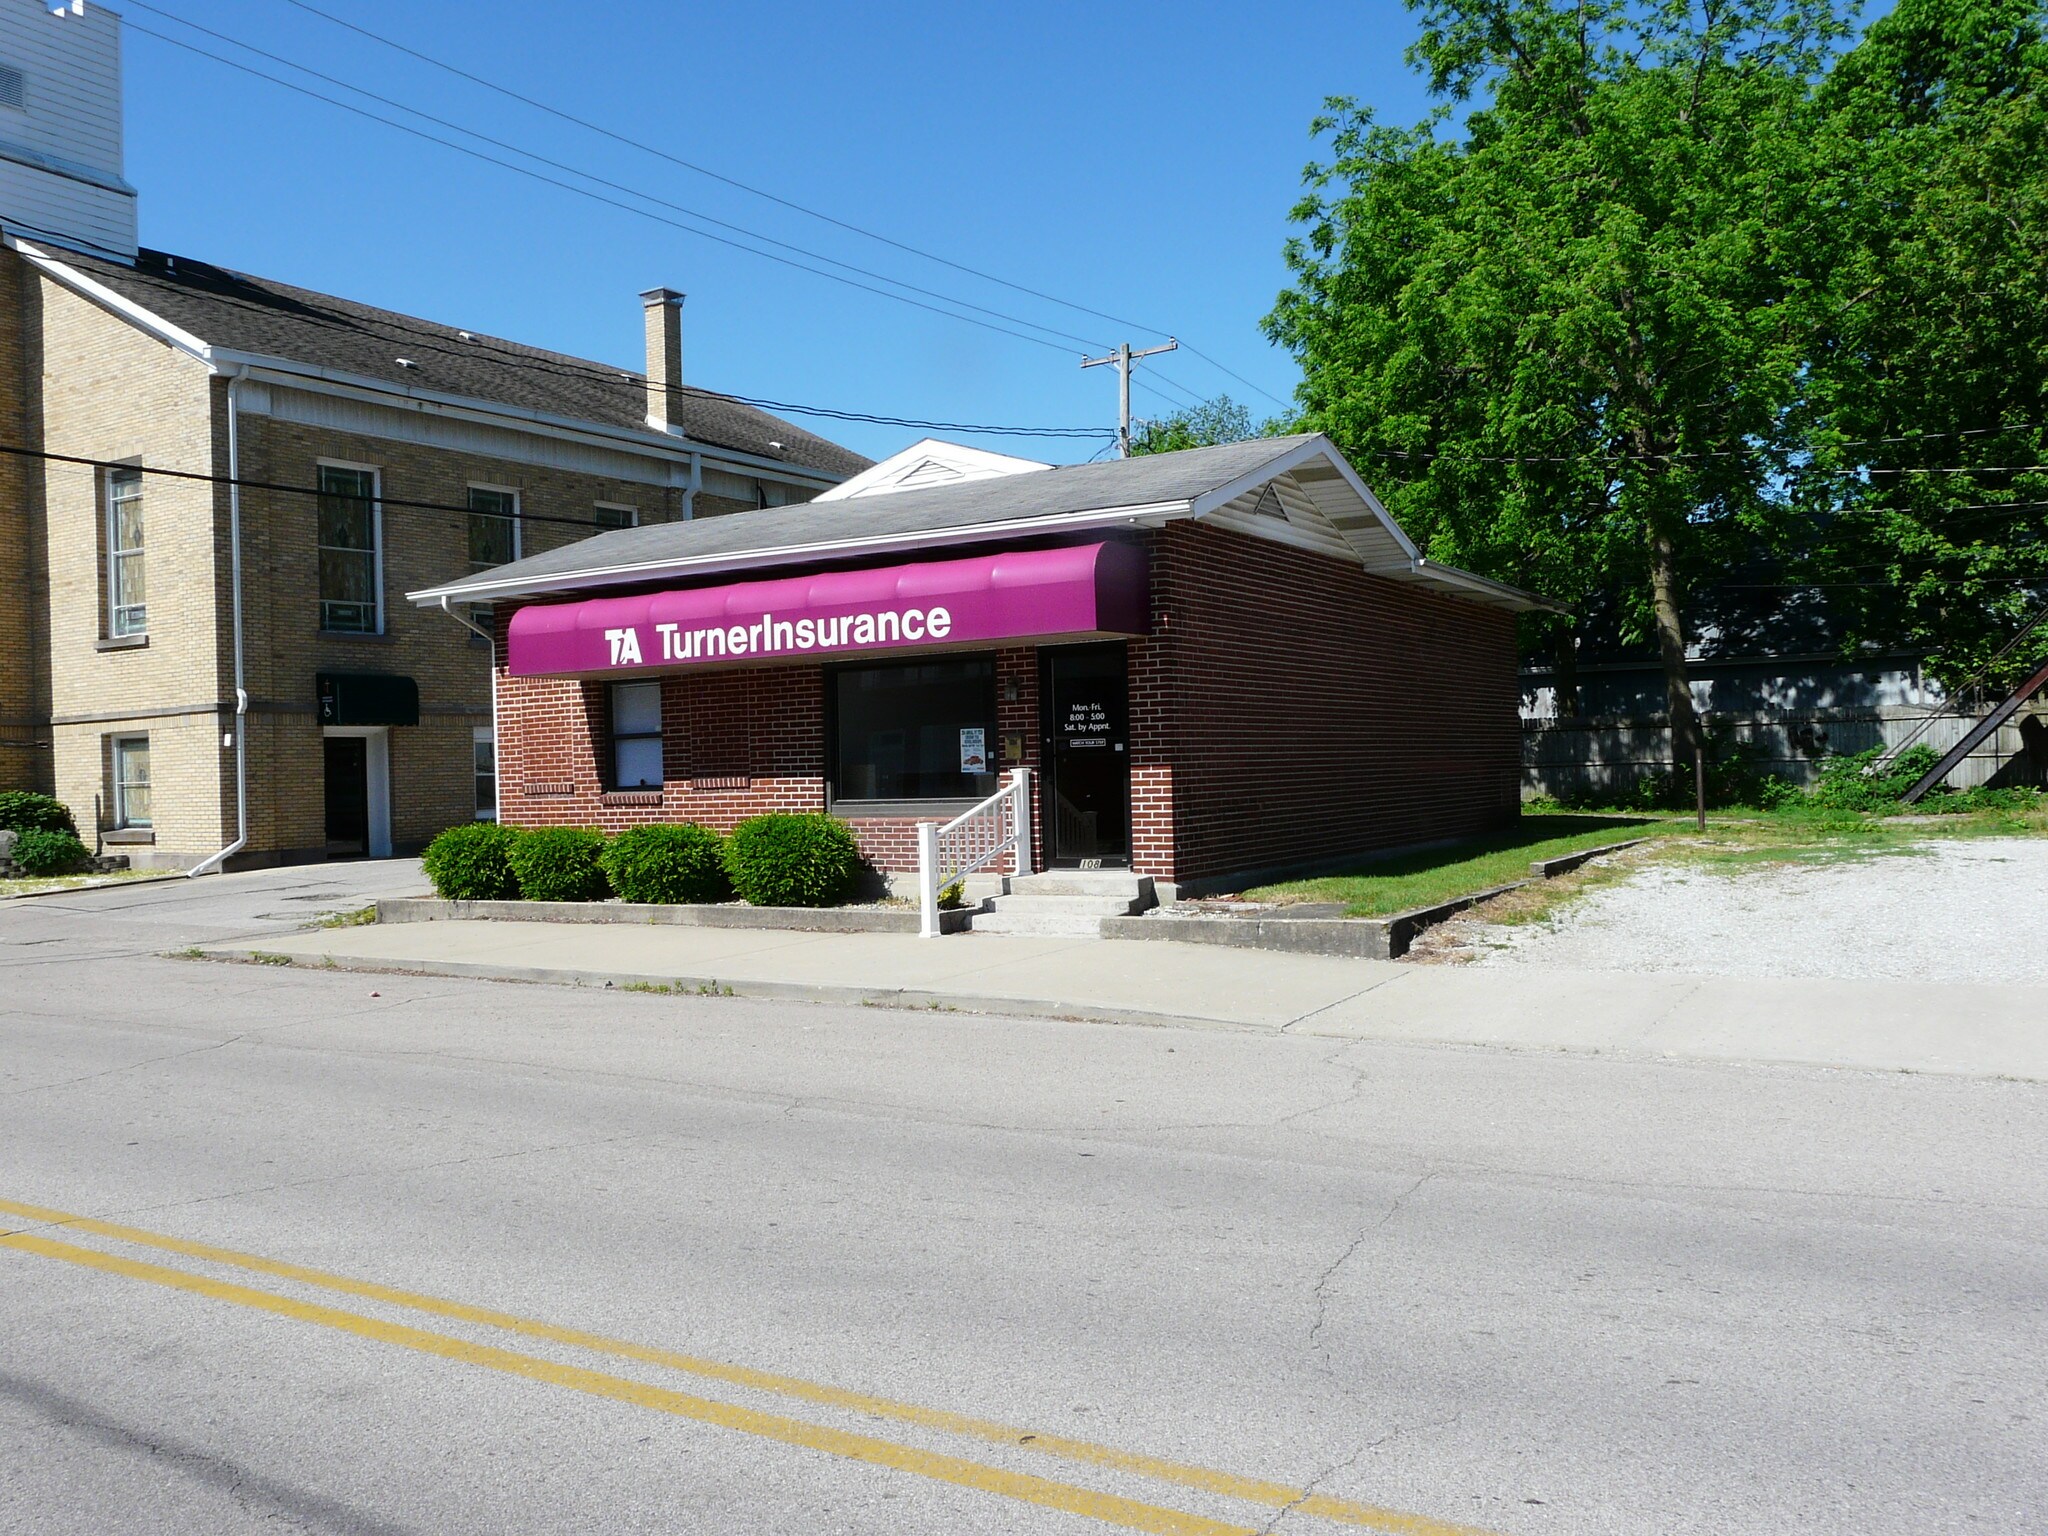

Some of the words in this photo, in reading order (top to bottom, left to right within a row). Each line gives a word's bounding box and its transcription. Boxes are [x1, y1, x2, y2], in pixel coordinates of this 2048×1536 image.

[604, 627, 643, 666] TA
[655, 605, 952, 661] TurnerInsurance
[1069, 713, 1085, 721] 8:00
[1090, 712, 1105, 721] 5:00
[1064, 723, 1077, 731] Sat.
[1078, 723, 1087, 733] by
[1082, 860, 1100, 869] 108
